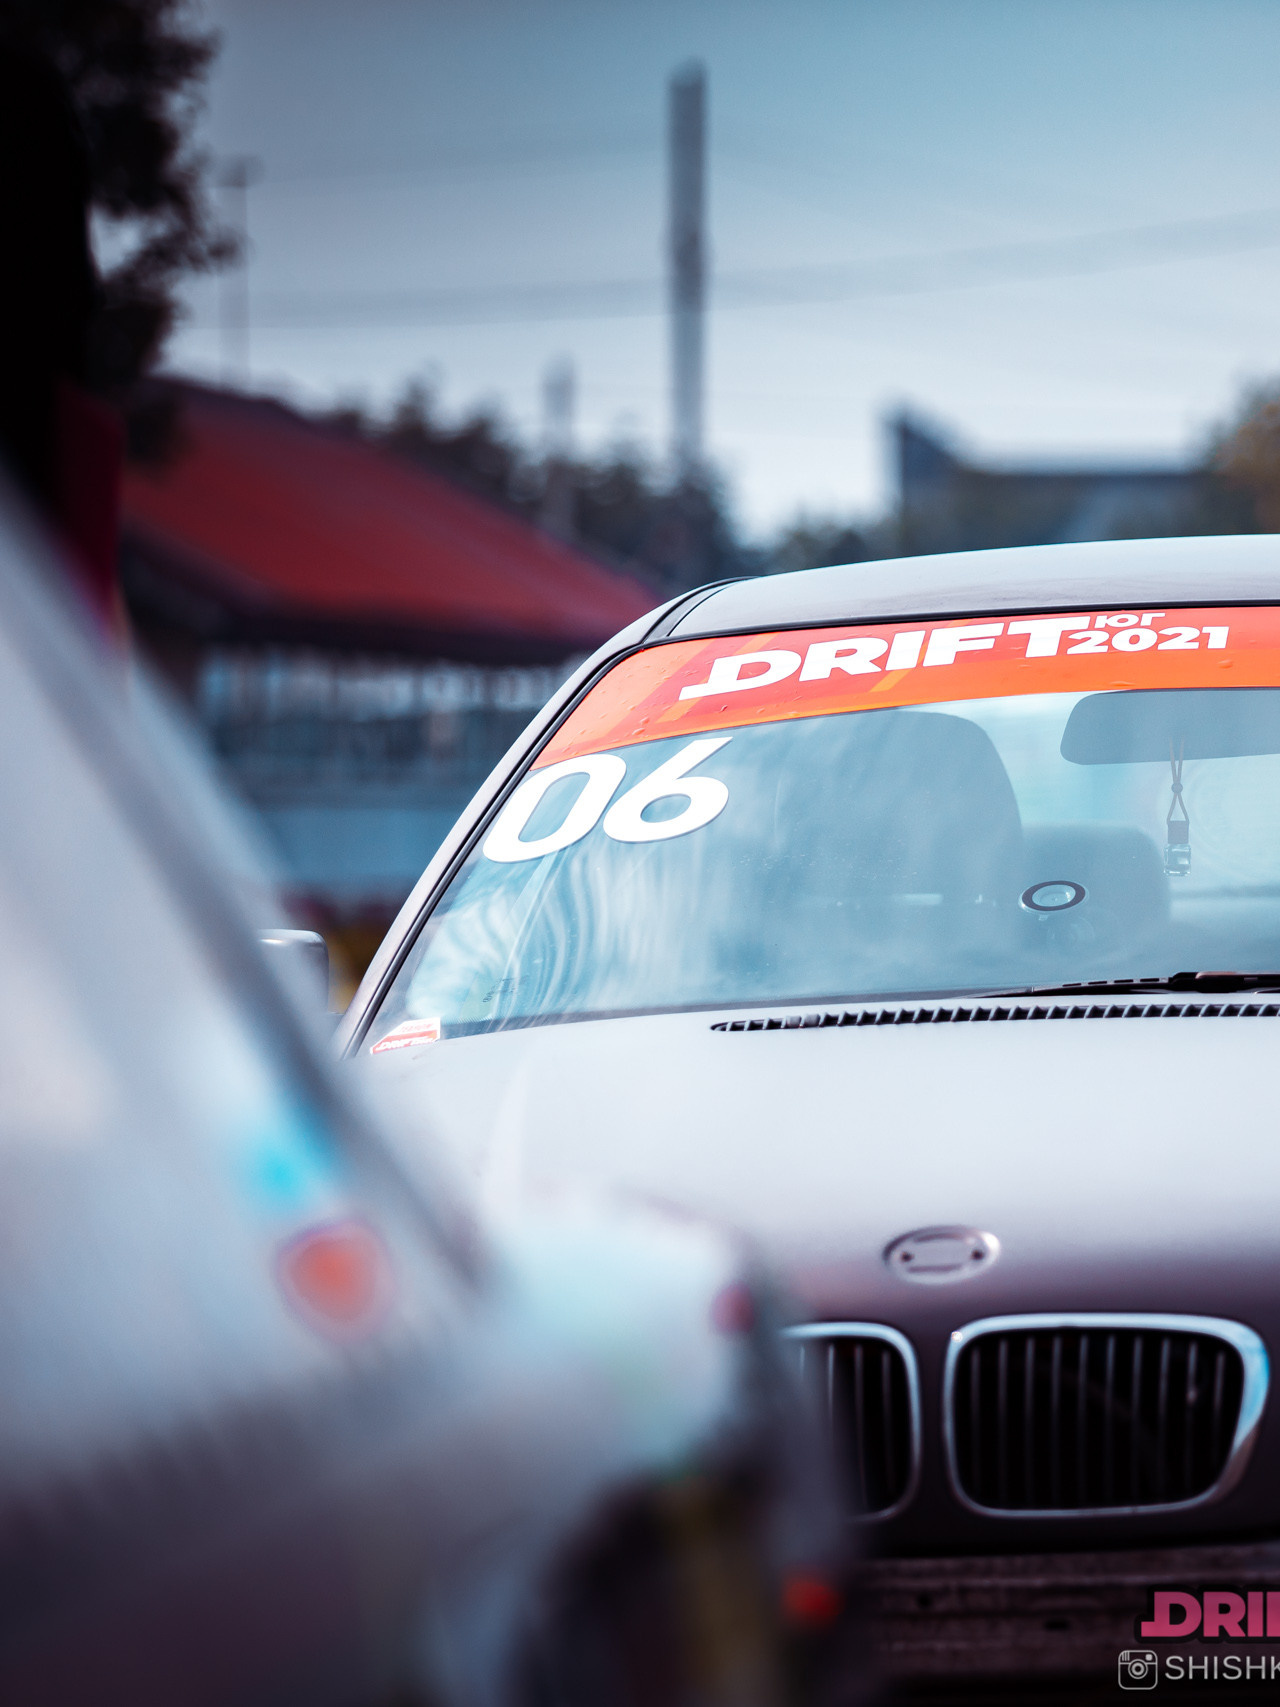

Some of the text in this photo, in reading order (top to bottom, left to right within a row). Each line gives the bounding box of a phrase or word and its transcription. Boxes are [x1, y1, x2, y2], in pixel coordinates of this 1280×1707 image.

[678, 616, 1091, 701] DRIFT
[1066, 626, 1230, 655] 2021
[482, 736, 733, 863] 06
